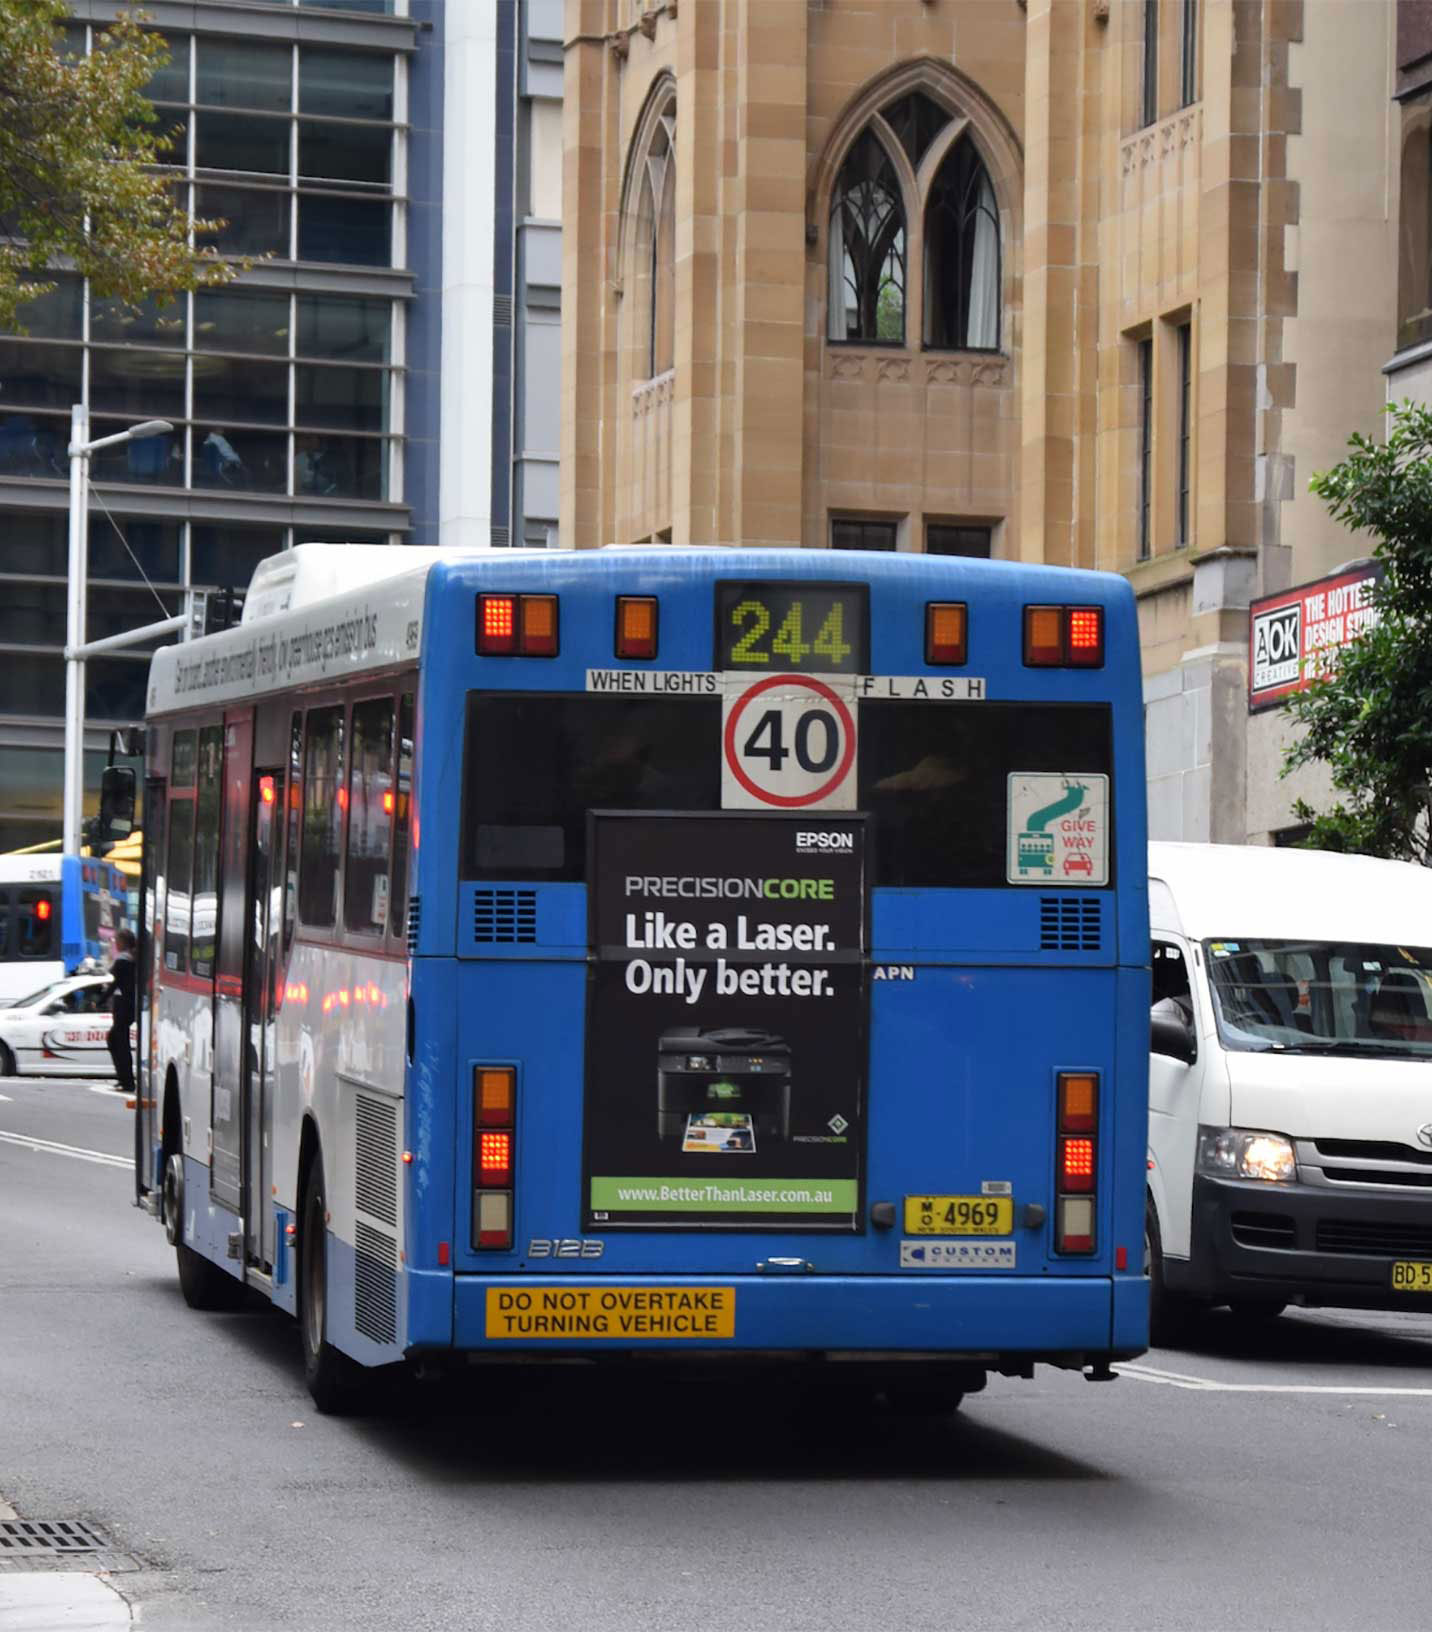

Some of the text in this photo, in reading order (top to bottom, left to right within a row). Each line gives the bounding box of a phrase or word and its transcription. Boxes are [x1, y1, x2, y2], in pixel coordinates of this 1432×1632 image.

[1305, 592, 1325, 624] THE
[731, 601, 850, 662] 244
[1256, 616, 1298, 663] AOK
[1305, 614, 1344, 652] DESIGN
[591, 672, 982, 697] WHEN LIGHTS FLASH
[1254, 661, 1298, 686] CREATIVE
[744, 709, 839, 773] 40
[1061, 820, 1096, 832] GIVE
[796, 832, 853, 847] EPSON
[1063, 836, 1094, 848] WAY
[626, 876, 834, 899] PRECISIONCORE
[626, 911, 835, 951] Like a Laser.
[625, 958, 834, 1004] Only better.
[873, 966, 914, 980] APN
[618, 1185, 833, 1203] www.BetterThanLaser.com.au
[528, 1239, 604, 1258] B12B
[931, 1247, 1012, 1256] CUSTOM
[499, 1293, 723, 1311] DO NOT OVERTAKE
[503, 1315, 718, 1332] TURNING VEHICLE
